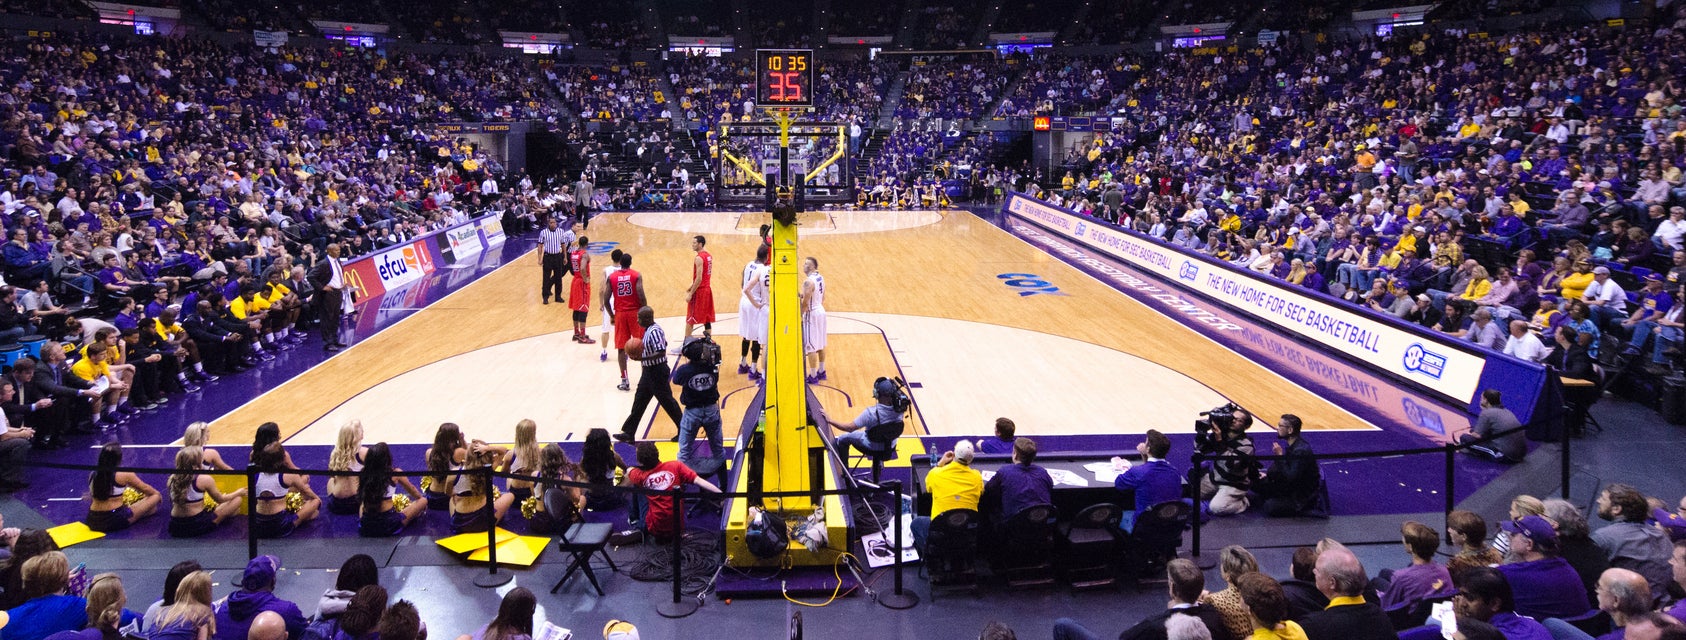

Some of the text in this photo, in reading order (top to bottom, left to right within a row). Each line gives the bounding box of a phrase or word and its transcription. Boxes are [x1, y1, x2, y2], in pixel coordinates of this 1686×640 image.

[768, 56, 806, 71] 10 35
[769, 72, 801, 100] 35
[1090, 229, 1099, 240] THE
[1098, 231, 1107, 243] NEW
[1108, 235, 1122, 249] HOME
[1121, 239, 1131, 253] FOR
[1129, 243, 1140, 256] SEC
[1139, 247, 1172, 270] BASKETBALL
[379, 254, 407, 280] efcu
[617, 281, 632, 296] 23
[1151, 294, 1243, 330] CENTER
[1206, 272, 1380, 353] THE NEW HOME FOR SEC BASKETBALL
[694, 375, 713, 386] FOX
[648, 473, 669, 488] FOX
